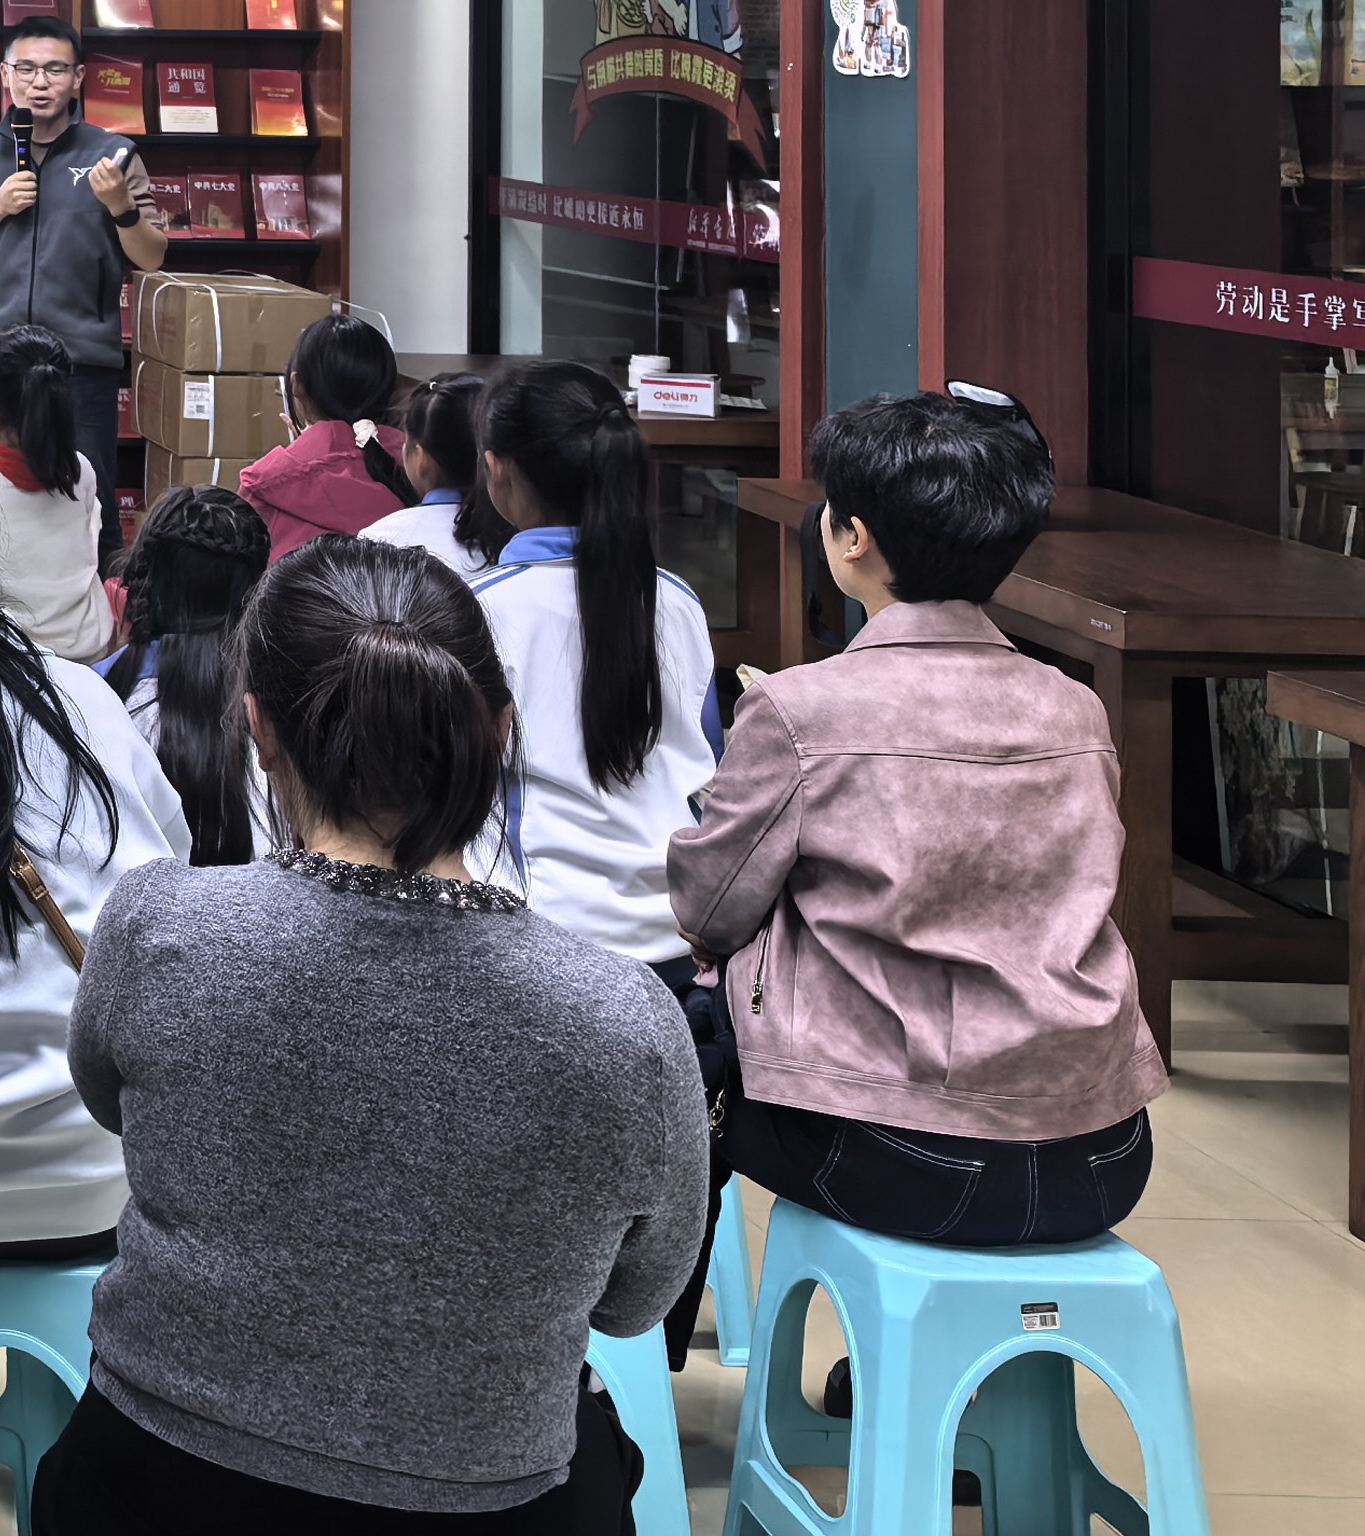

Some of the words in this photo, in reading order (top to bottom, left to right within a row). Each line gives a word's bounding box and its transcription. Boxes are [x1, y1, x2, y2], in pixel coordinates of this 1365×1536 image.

[167, 67, 206, 81] 共和国
[167, 81, 207, 94] 通览
